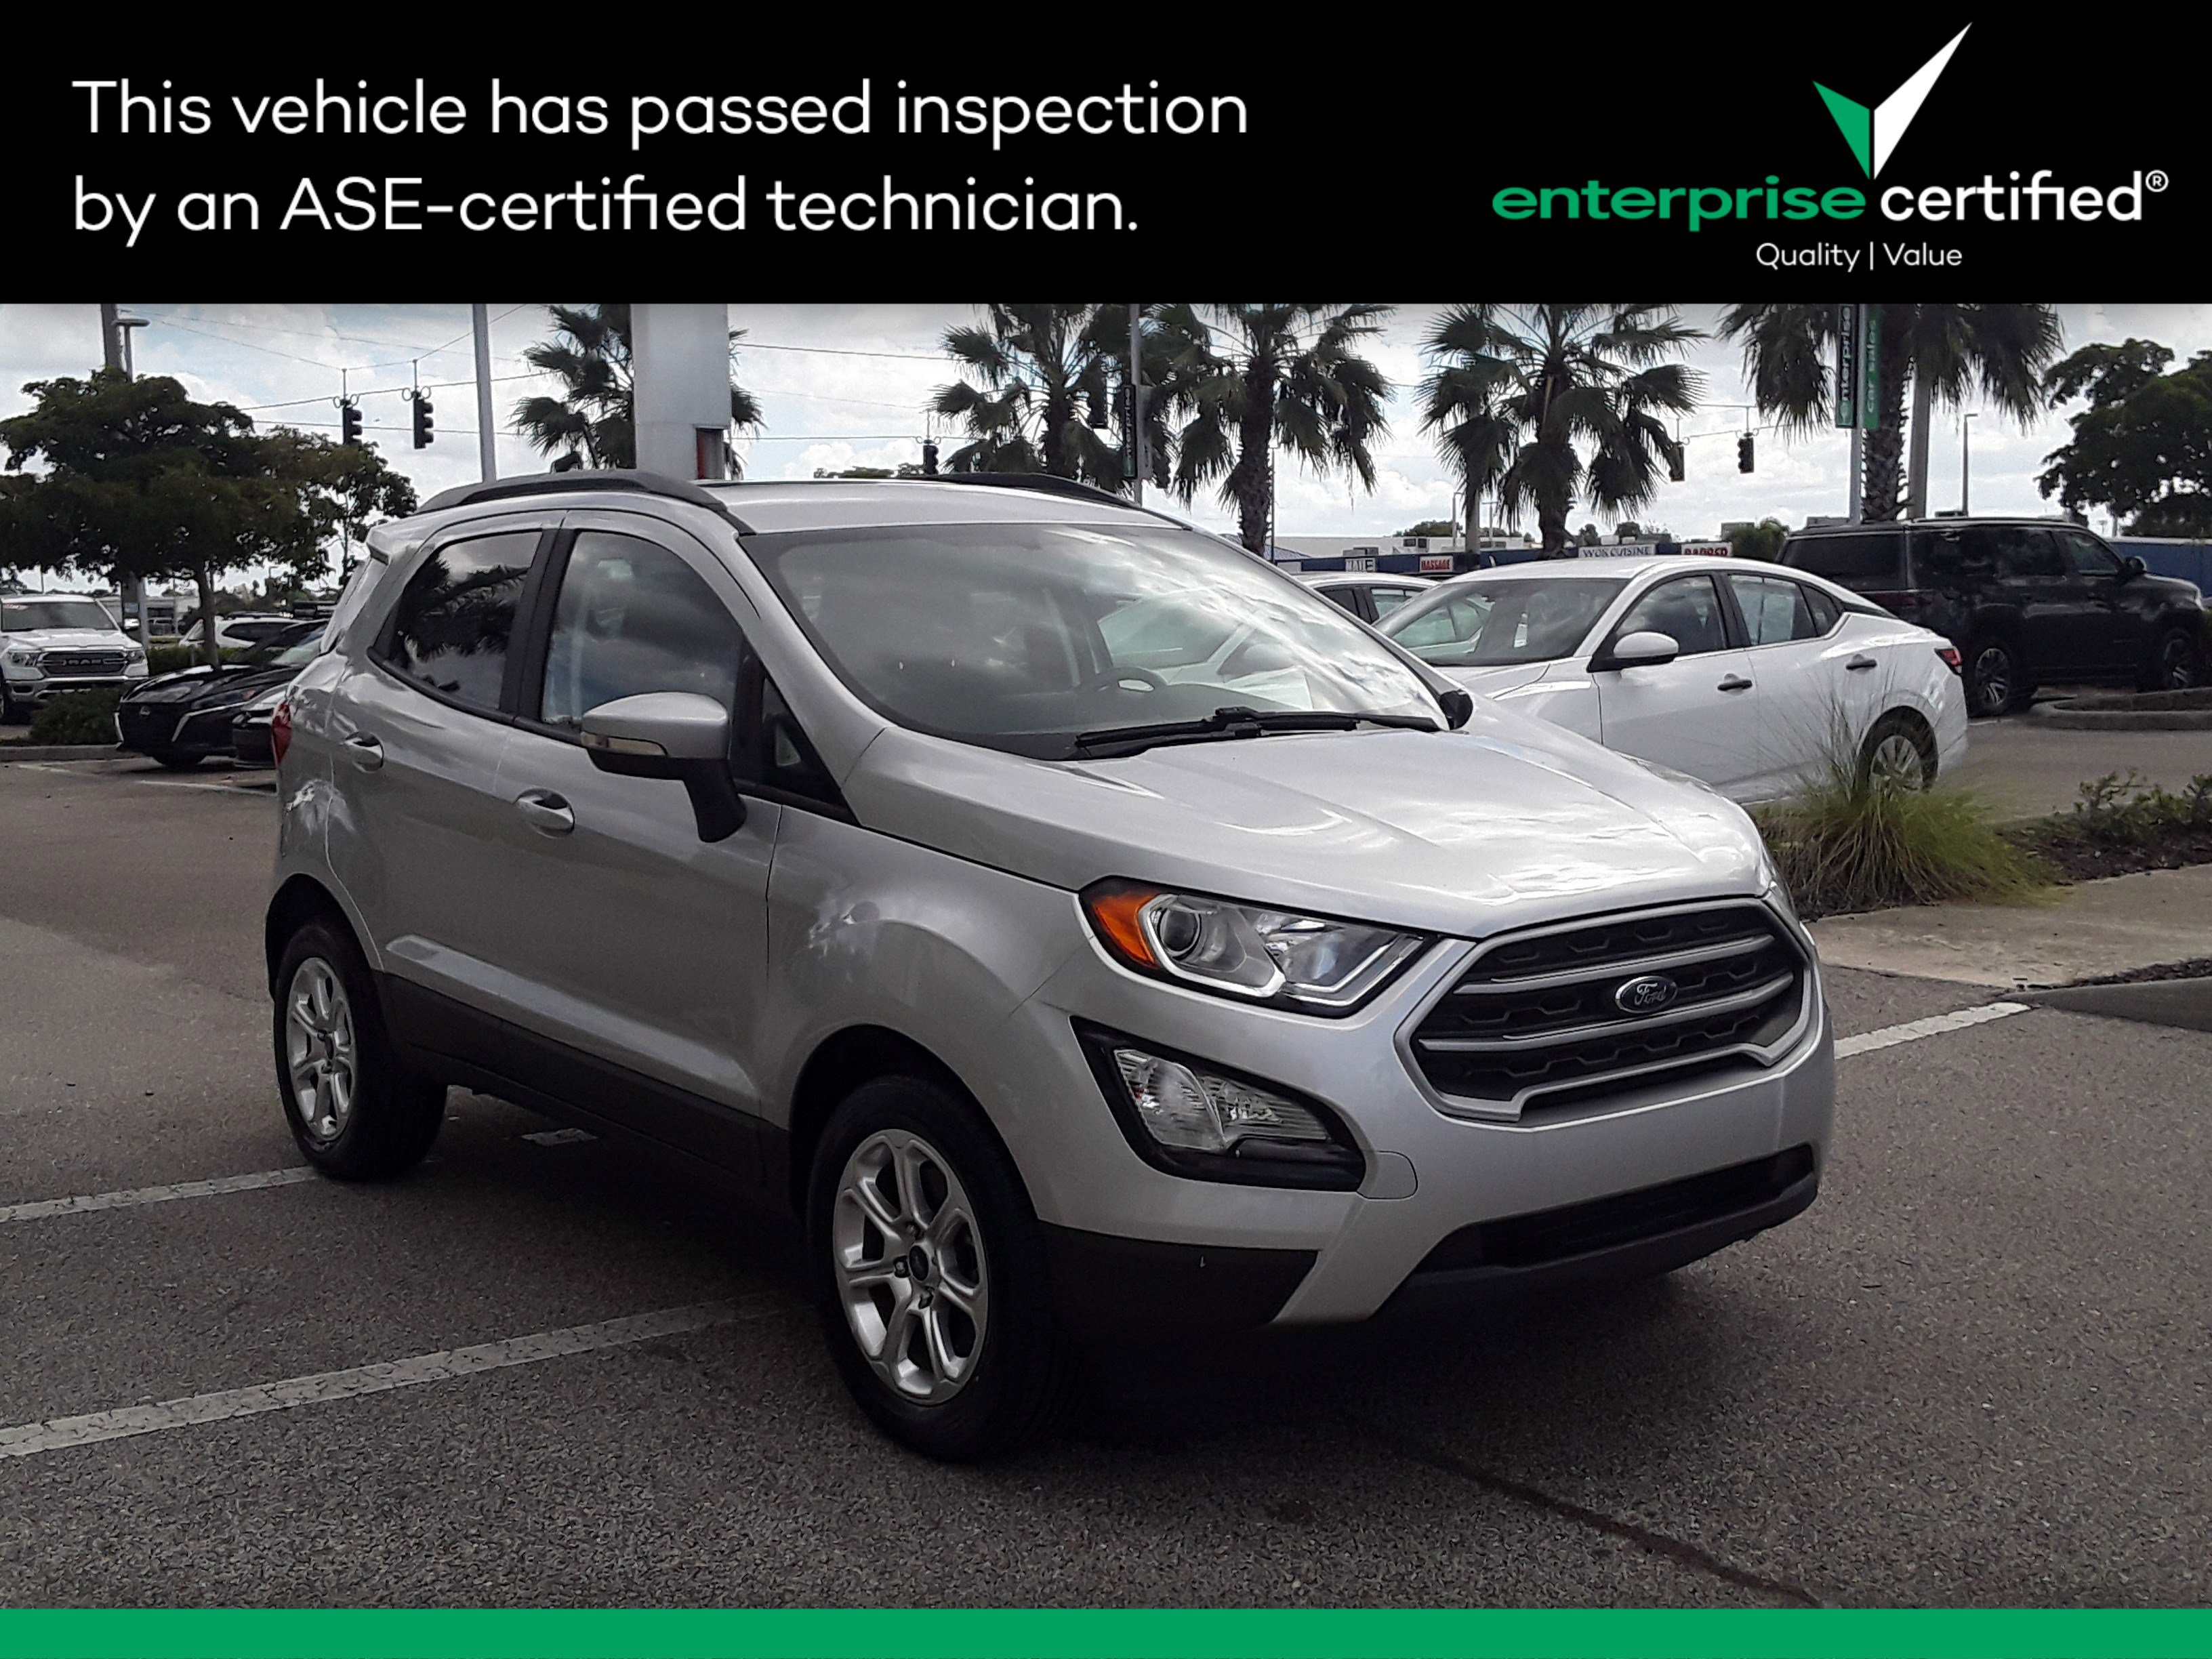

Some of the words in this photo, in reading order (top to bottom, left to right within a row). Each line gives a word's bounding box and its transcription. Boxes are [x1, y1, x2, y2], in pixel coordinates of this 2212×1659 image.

[1867, 319, 1877, 371] sales
[1867, 377, 1875, 413] car
[1634, 983, 1667, 1006] Ford
